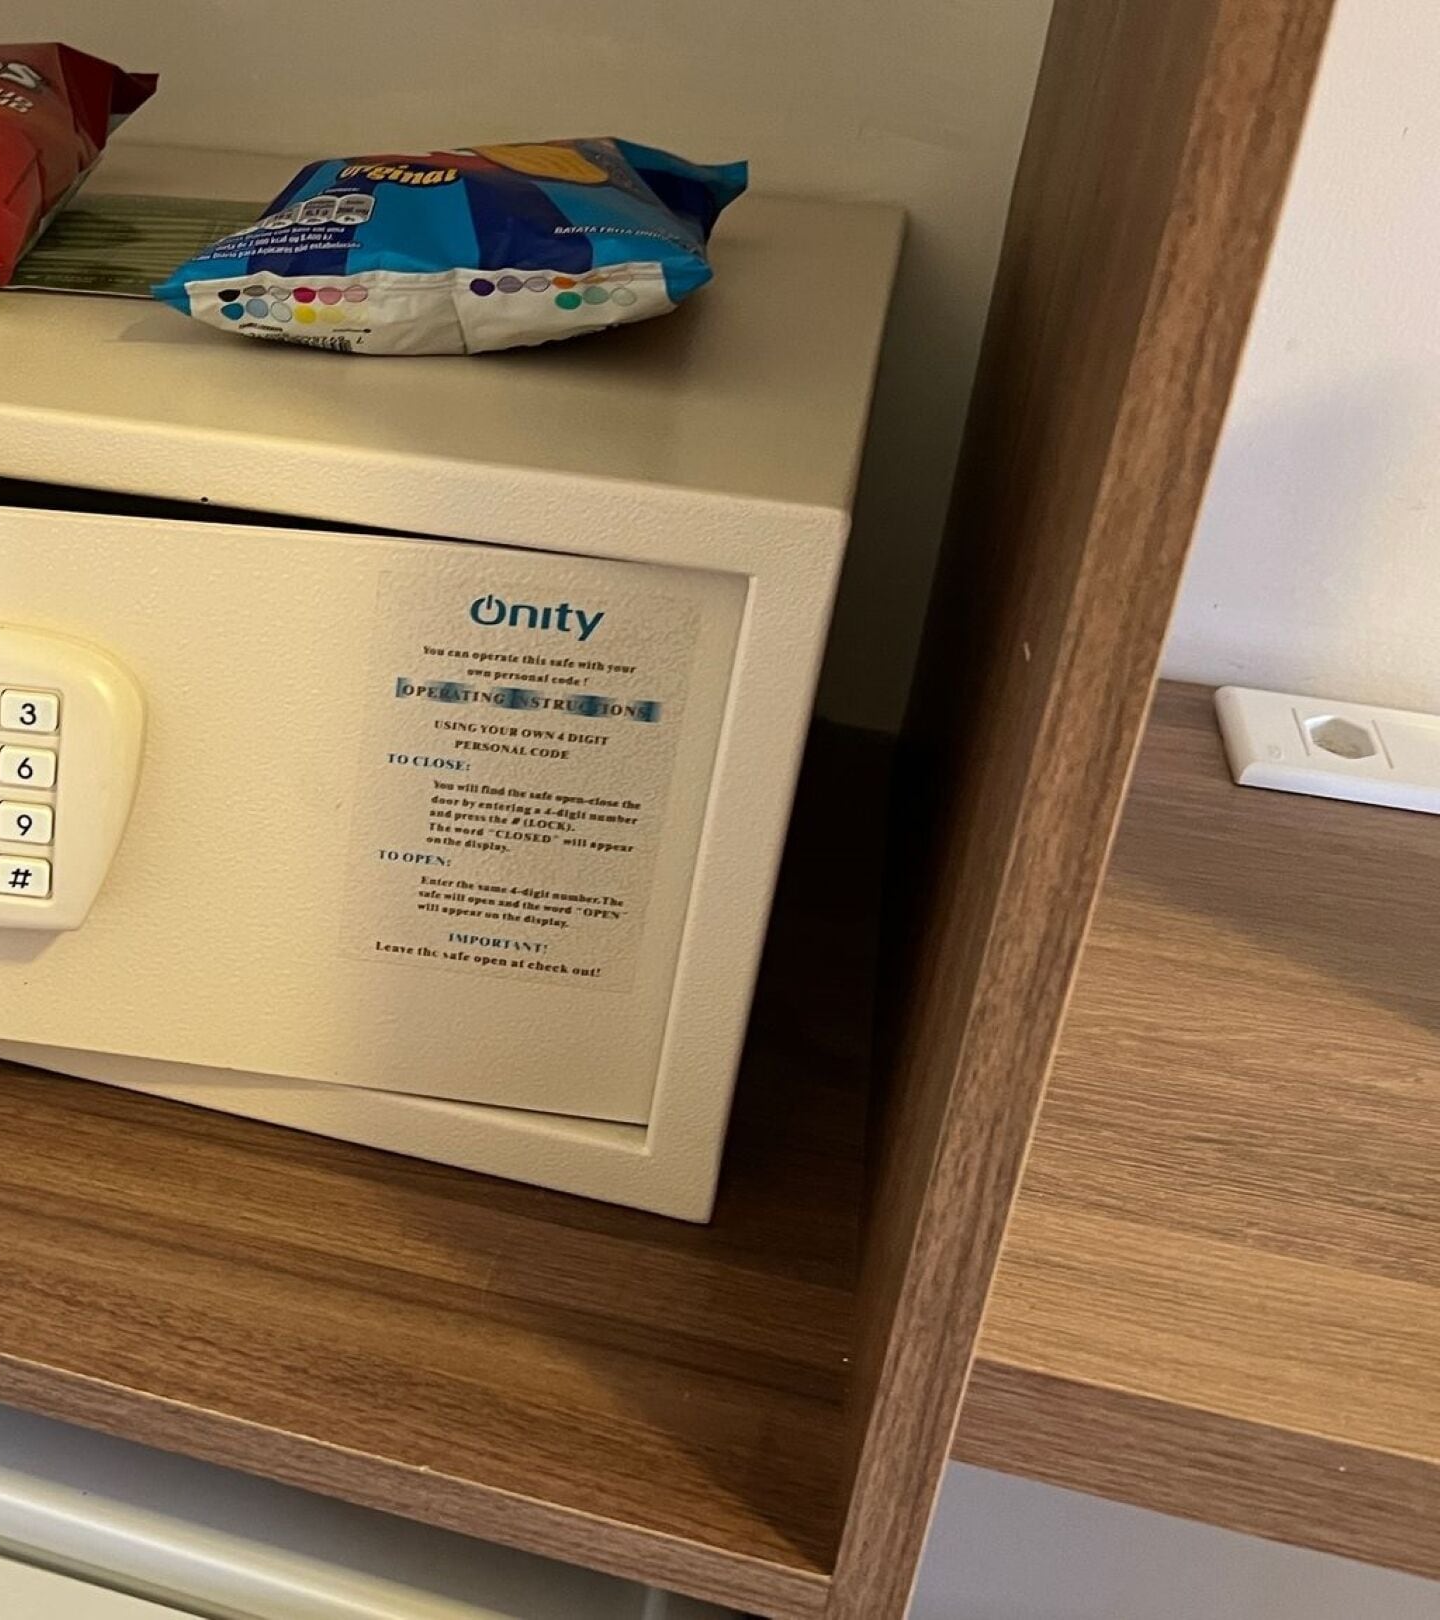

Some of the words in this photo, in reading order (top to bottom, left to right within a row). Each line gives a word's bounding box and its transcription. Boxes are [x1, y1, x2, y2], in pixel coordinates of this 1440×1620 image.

[469, 593, 606, 642] Onity
[423, 646, 445, 657] You
[447, 649, 469, 659] can
[471, 652, 519, 664] operate
[522, 655, 546, 666] this
[549, 657, 575, 669] safe
[577, 660, 605, 671] with
[606, 663, 637, 675] your
[466, 668, 491, 678] own
[494, 671, 550, 684] personal
[402, 684, 506, 706] OPERATING
[508, 691, 646, 718] NSTRUCIONS
[19, 702, 37, 726] 3
[434, 719, 477, 733] USING
[480, 724, 518, 738] YOUR
[520, 728, 555, 740] OWN
[556, 731, 564, 741] 4
[567, 733, 610, 746] DIGIT
[387, 752, 409, 765] TO
[412, 755, 471, 771] CLOSE:
[454, 740, 527, 756] PERSONAL
[529, 747, 570, 760] CODE
[17, 757, 33, 780] 6
[433, 780, 454, 791] You
[457, 783, 479, 793] will
[481, 785, 505, 796] find
[507, 788, 526, 798] the
[529, 790, 553, 801] safe
[555, 795, 619, 808] open-close
[621, 800, 641, 811] the
[429, 808, 452, 819] and
[454, 812, 487, 823] press
[488, 814, 508, 825] the
[511, 817, 521, 827] #
[522, 818, 576, 833] (LOCK).
[430, 795, 459, 806] door
[462, 798, 476, 810] by
[477, 801, 531, 816] entering
[543, 808, 587, 821] 4-digit
[588, 814, 638, 826] number
[16, 814, 33, 836] 9
[428, 822, 451, 833] The
[454, 826, 484, 837] word
[562, 838, 588, 848] will
[589, 841, 634, 853] appear
[426, 836, 441, 845] on
[443, 837, 462, 848] the
[464, 839, 510, 854] display.
[378, 849, 399, 862] TO
[402, 852, 452, 868] OPEN:
[8, 868, 33, 889] #
[420, 875, 454, 888] Enter
[456, 879, 475, 890] the
[477, 884, 508, 894] same
[509, 886, 550, 900] 4-digit
[418, 889, 442, 900] safe
[443, 892, 466, 902] will
[467, 896, 496, 907] open
[497, 898, 520, 909] and
[522, 900, 541, 911] the
[543, 904, 573, 915] word
[417, 902, 440, 913] will
[441, 906, 482, 919] appear
[484, 911, 500, 920] on
[502, 912, 521, 923] the
[523, 915, 570, 930] display.
[448, 932, 548, 954] IMPORTANT!
[376, 941, 414, 956] Leave
[417, 946, 438, 958] the
[441, 950, 471, 962] safe
[474, 955, 508, 967] open
[511, 958, 525, 969] at
[527, 961, 568, 975] check
[572, 967, 602, 979] out!
